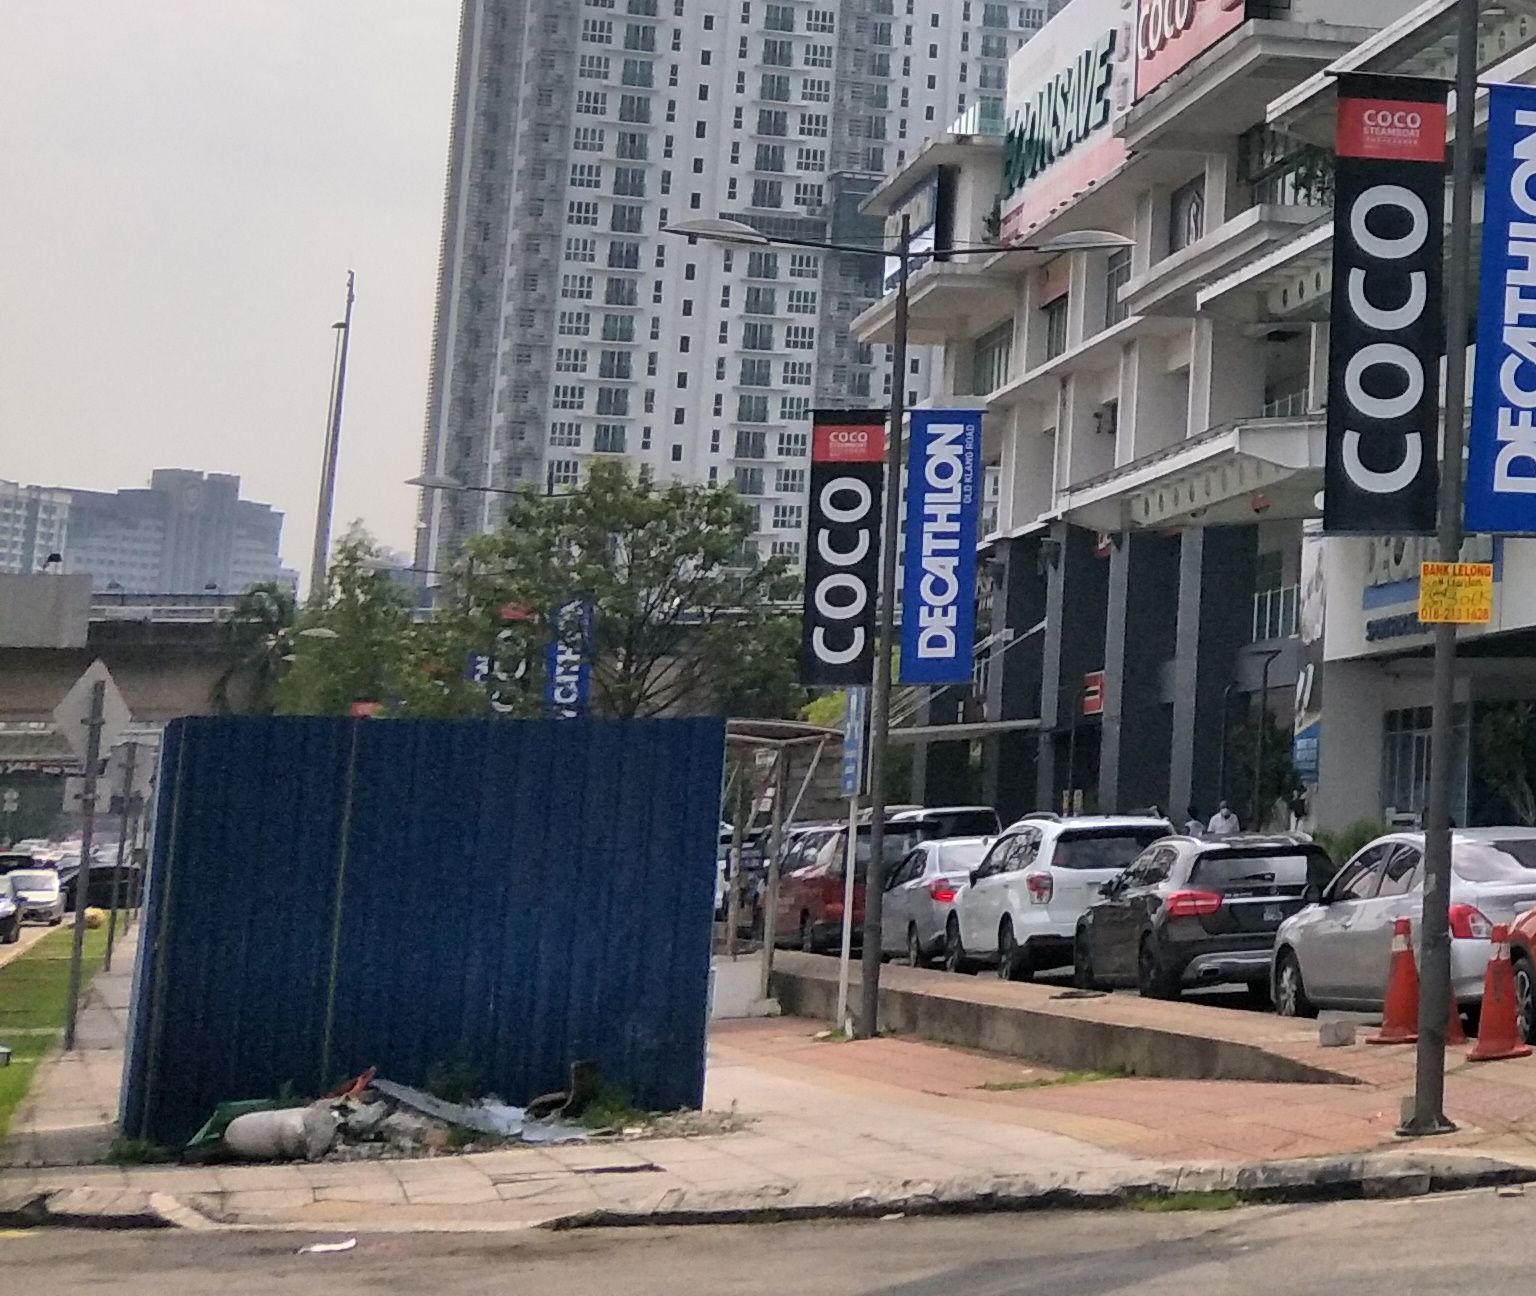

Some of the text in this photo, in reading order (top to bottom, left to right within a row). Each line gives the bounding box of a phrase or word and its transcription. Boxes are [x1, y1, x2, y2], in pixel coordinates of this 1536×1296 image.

[1363, 109, 1421, 129] COCO
[1340, 183, 1429, 495] COCO
[829, 431, 868, 443] COCO
[812, 476, 872, 665] COCO
[917, 423, 964, 659] DECATHLON
[1422, 564, 1492, 577] BANK LELONG
